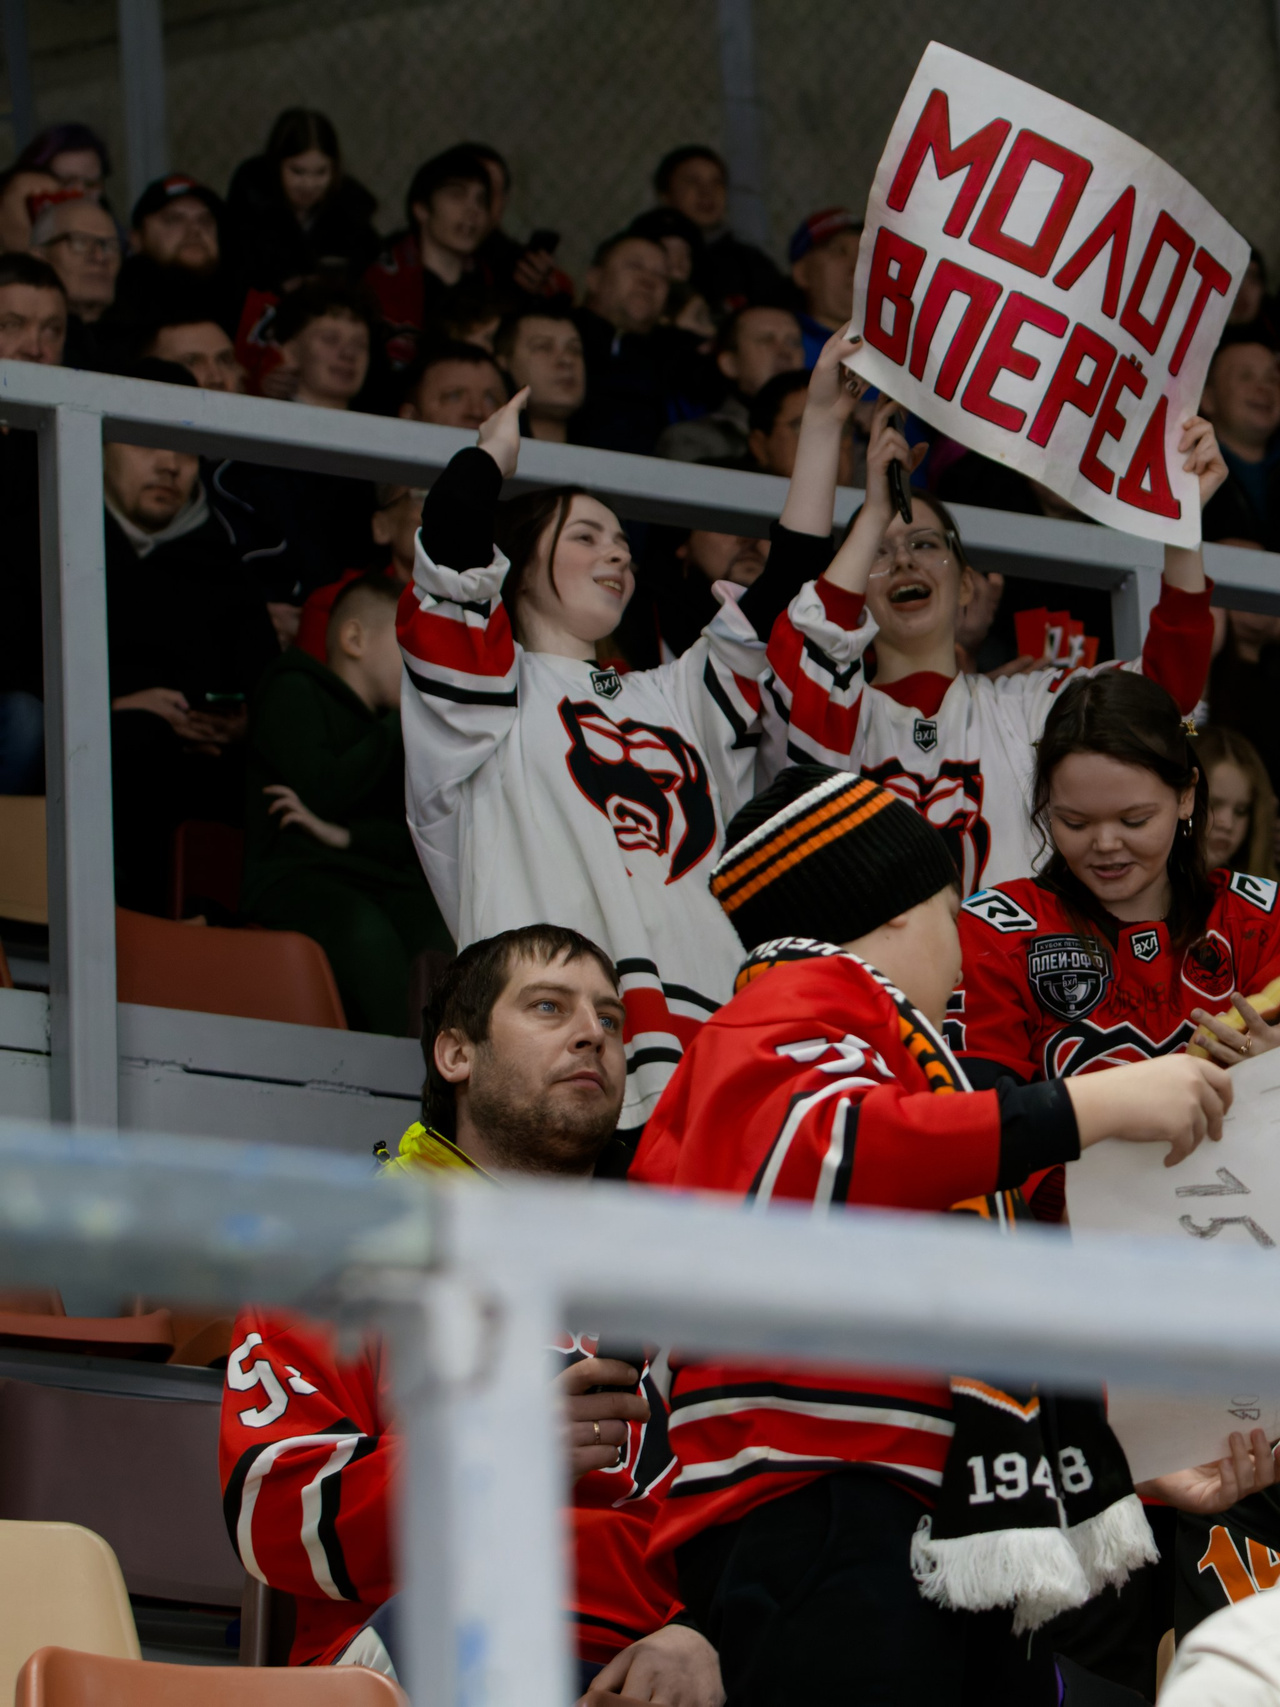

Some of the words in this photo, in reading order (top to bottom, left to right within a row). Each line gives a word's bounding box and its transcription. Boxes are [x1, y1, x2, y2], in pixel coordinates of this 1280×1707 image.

[887, 88, 1232, 377] МОЛОТ
[863, 226, 1181, 519] ВПЕРЁД
[595, 676, 619, 693] ВХЛ
[915, 729, 936, 741] ВХЛ
[1133, 936, 1160, 956] ВХЛ
[966, 1445, 1094, 1505] 1948
